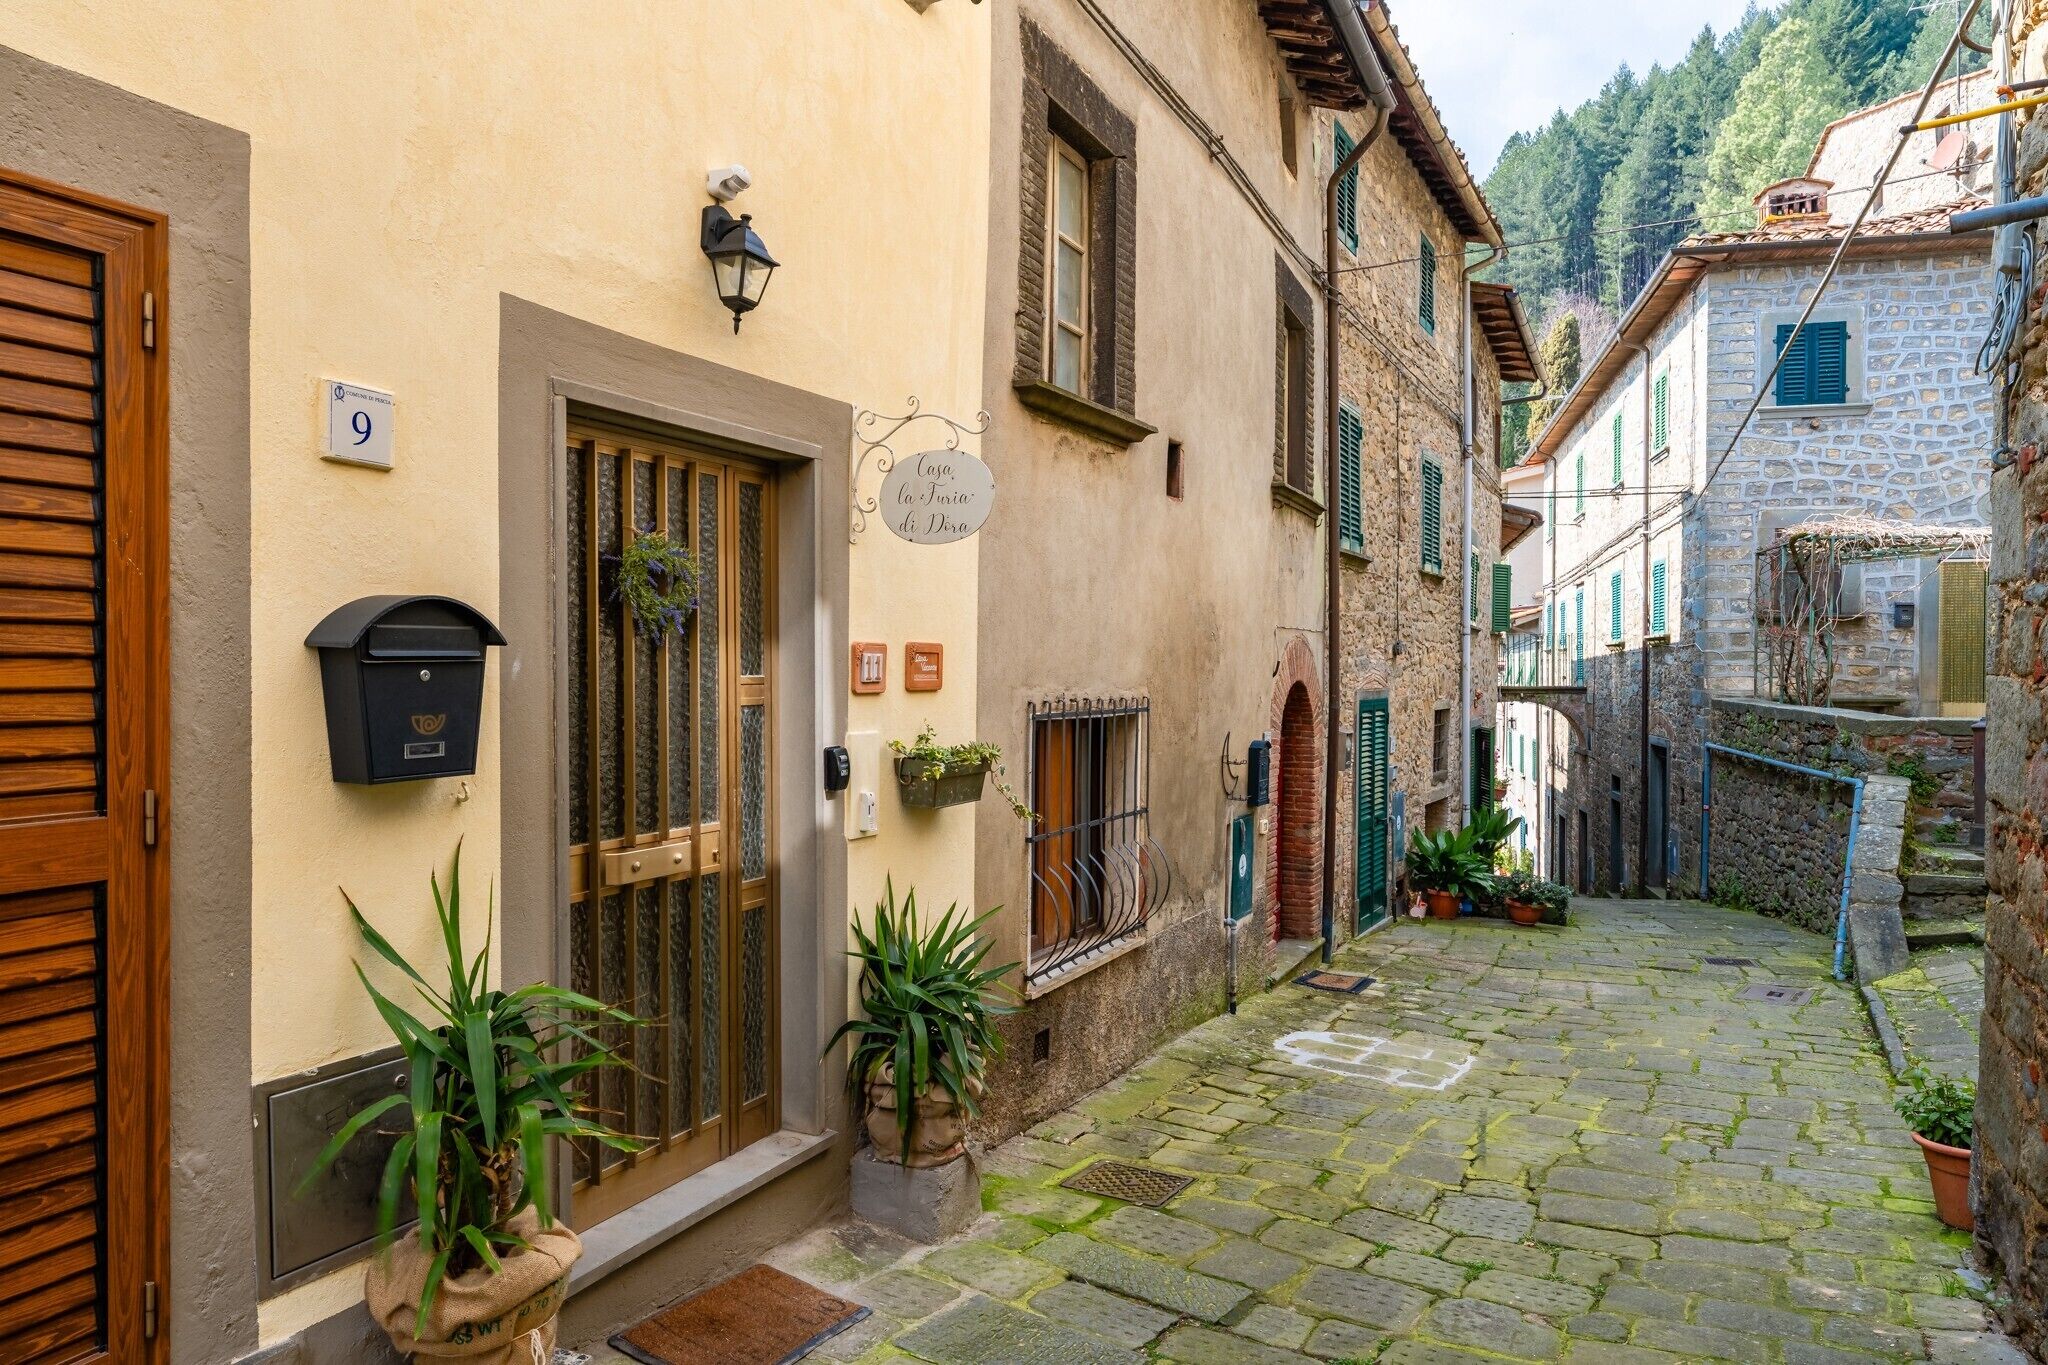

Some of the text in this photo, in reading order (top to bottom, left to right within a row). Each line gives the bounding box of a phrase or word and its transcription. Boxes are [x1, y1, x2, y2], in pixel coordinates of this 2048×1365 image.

[351, 411, 372, 446] 9
[917, 453, 954, 480] Casa
[897, 481, 916, 505] la
[899, 510, 971, 536] di Dora
[865, 655, 883, 681] 11
